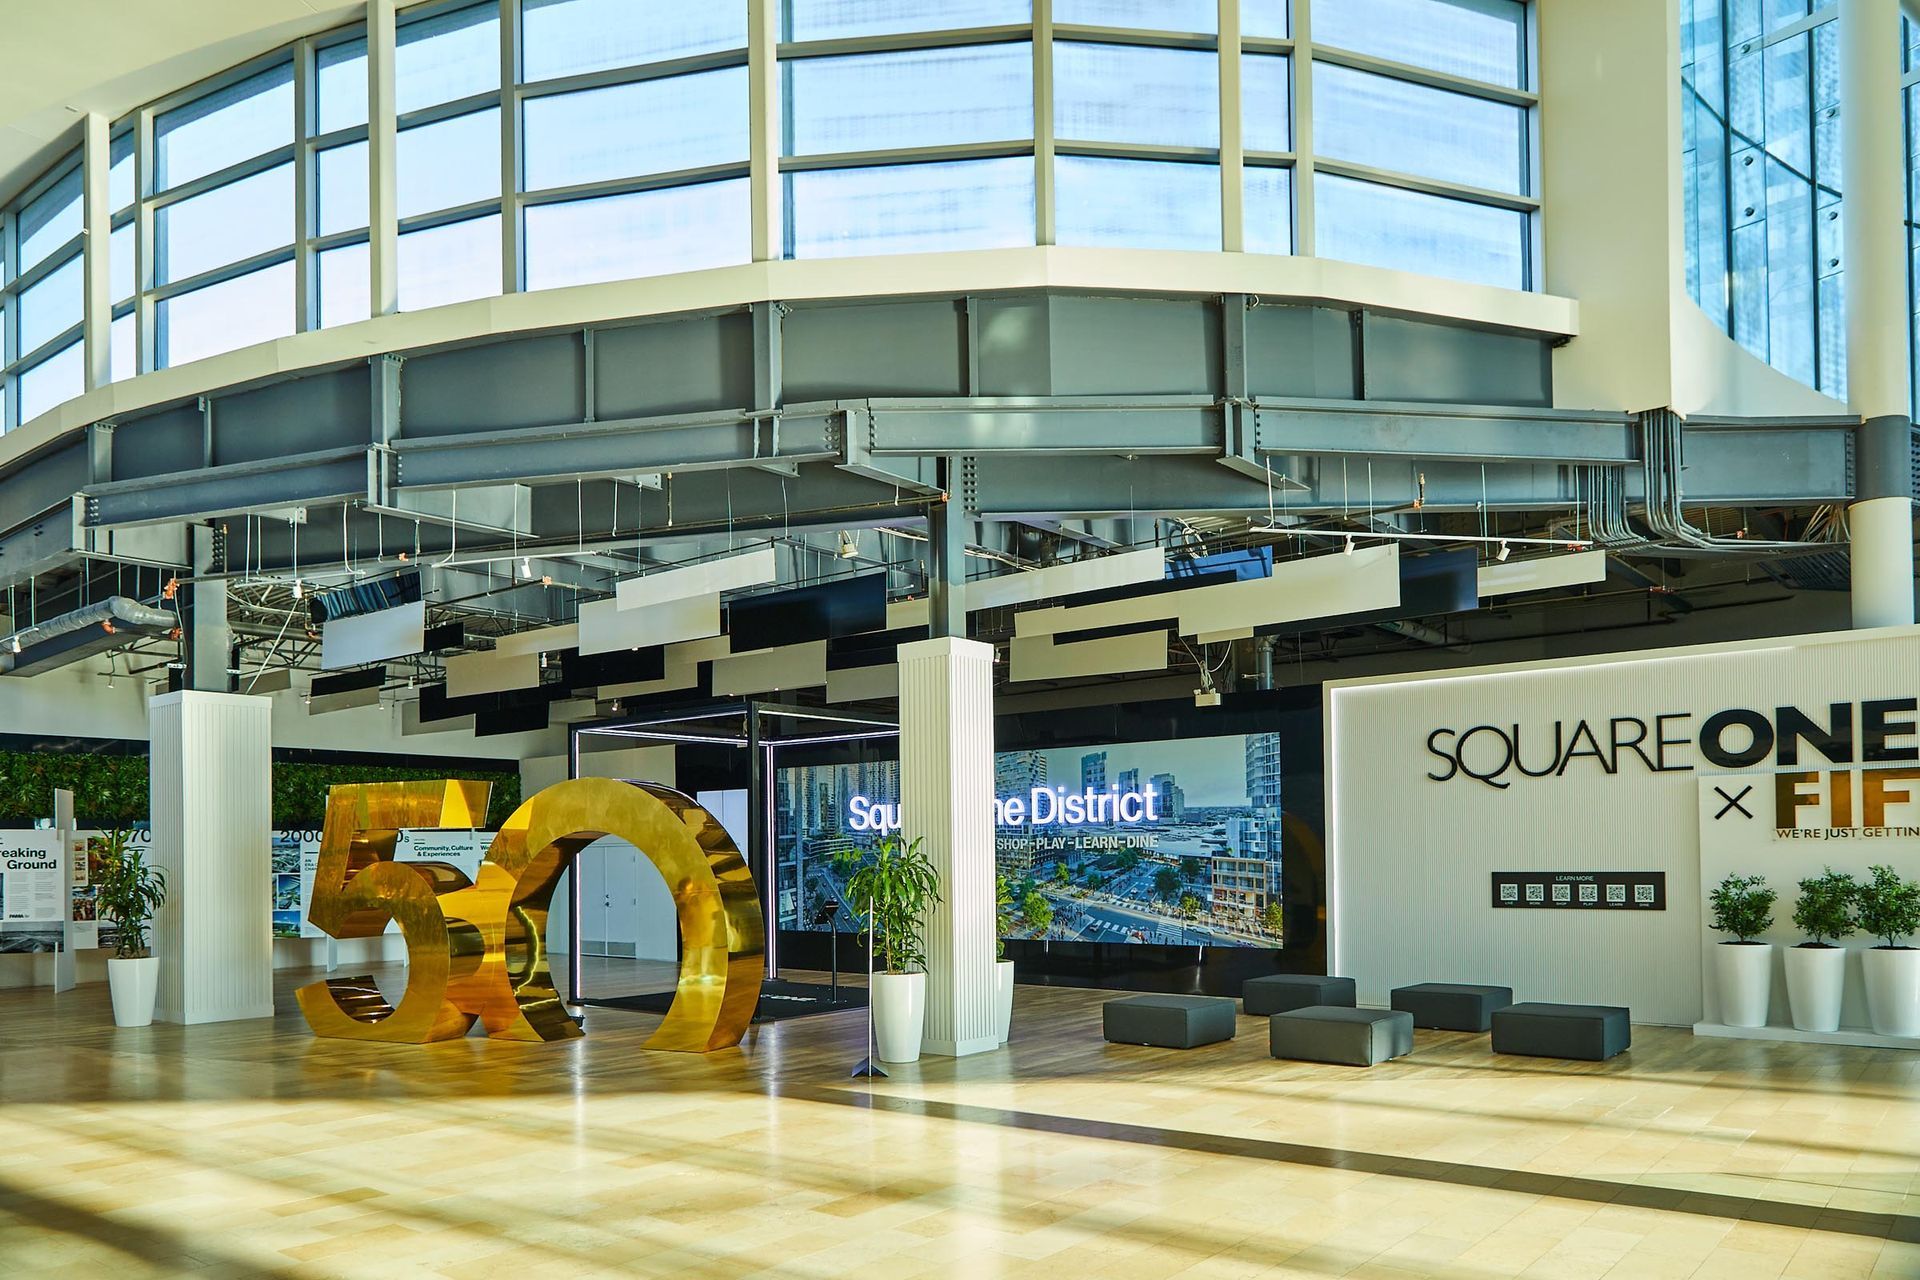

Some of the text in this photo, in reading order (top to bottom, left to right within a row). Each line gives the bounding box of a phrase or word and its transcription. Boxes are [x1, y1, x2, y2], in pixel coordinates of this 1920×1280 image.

[1030, 783, 1159, 825] District
[1777, 828, 1821, 839] WE'RE
[1824, 828, 1858, 840] JUST
[7, 859, 57, 870] Ground
